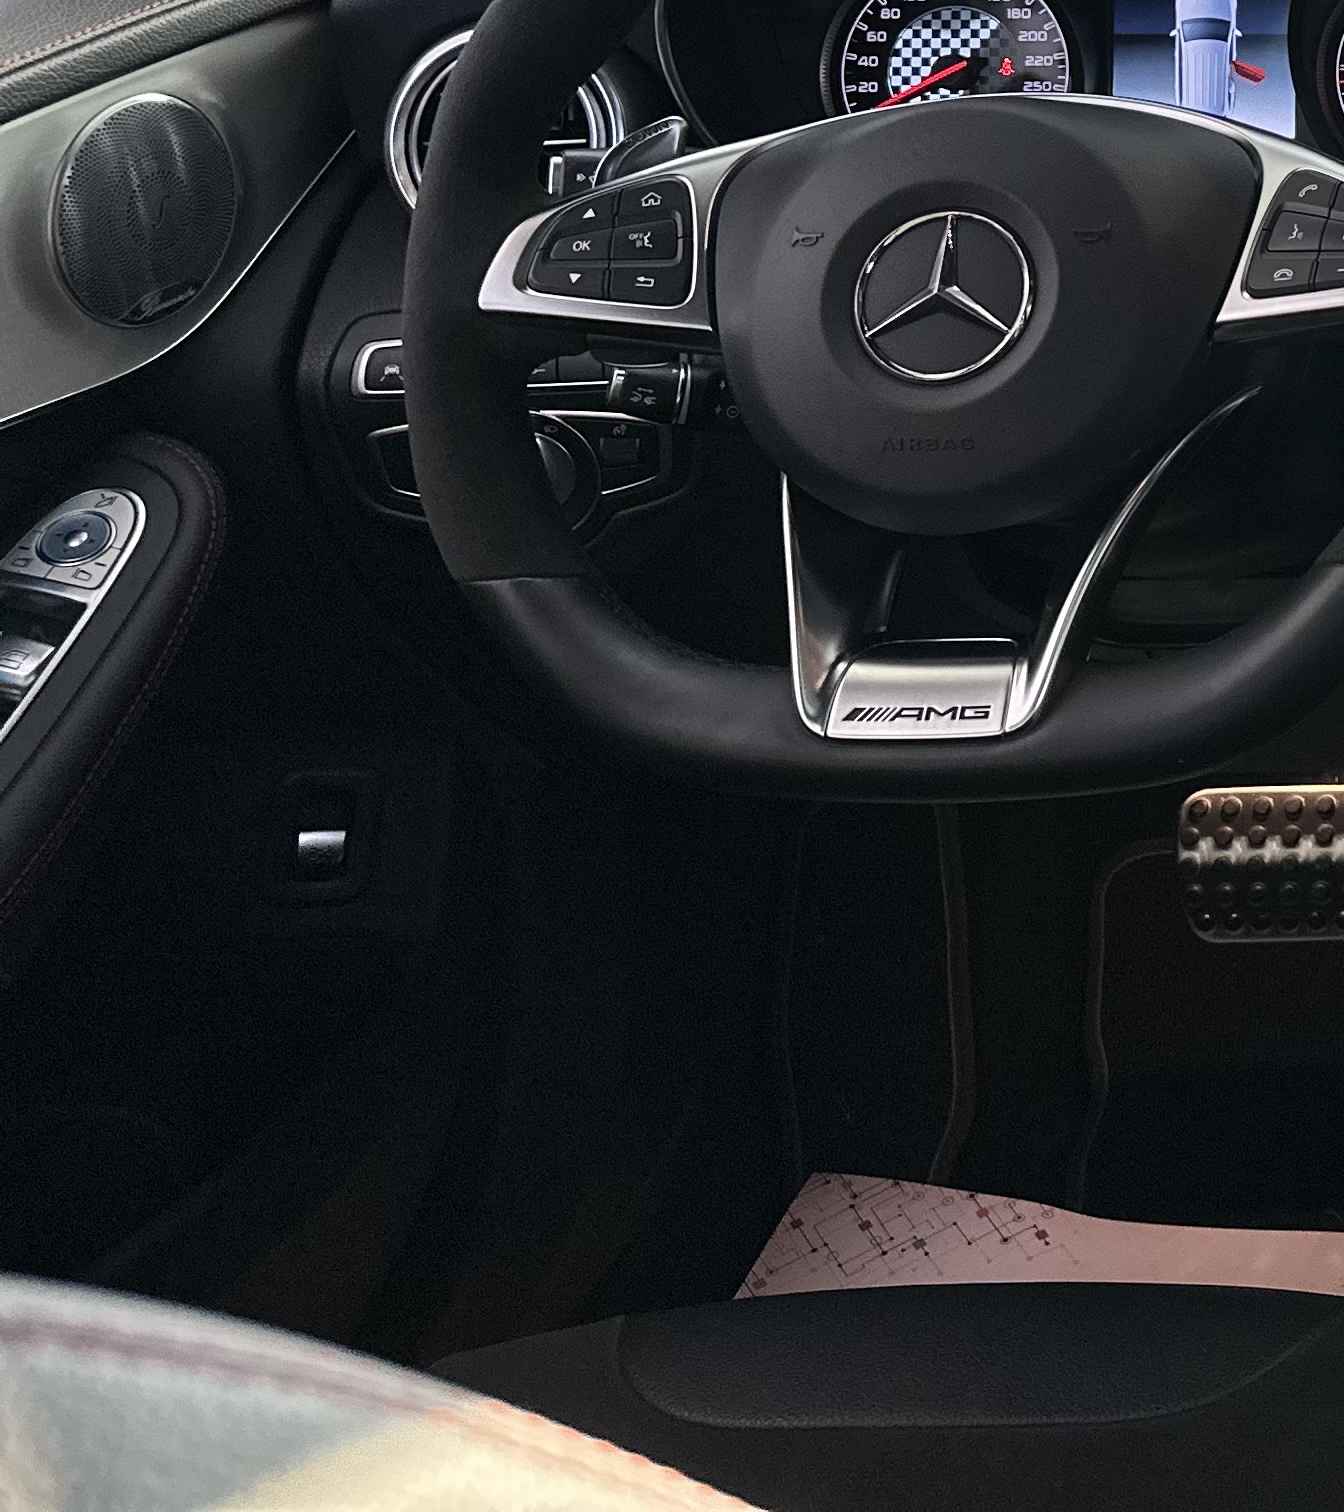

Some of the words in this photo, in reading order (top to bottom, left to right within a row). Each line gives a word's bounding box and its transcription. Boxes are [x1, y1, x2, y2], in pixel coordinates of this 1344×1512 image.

[880, 8, 900, 20] 80
[1007, 8, 1031, 20] 180
[867, 31, 887, 42] 60
[1018, 31, 1048, 42] 200
[858, 56, 878, 67] 40
[1025, 56, 1053, 67] 220
[858, 82, 878, 93] 20
[1023, 81, 1052, 92] 250
[572, 240, 592, 252] OK
[881, 437, 975, 452] AIRBAG
[888, 705, 991, 722] AMG
